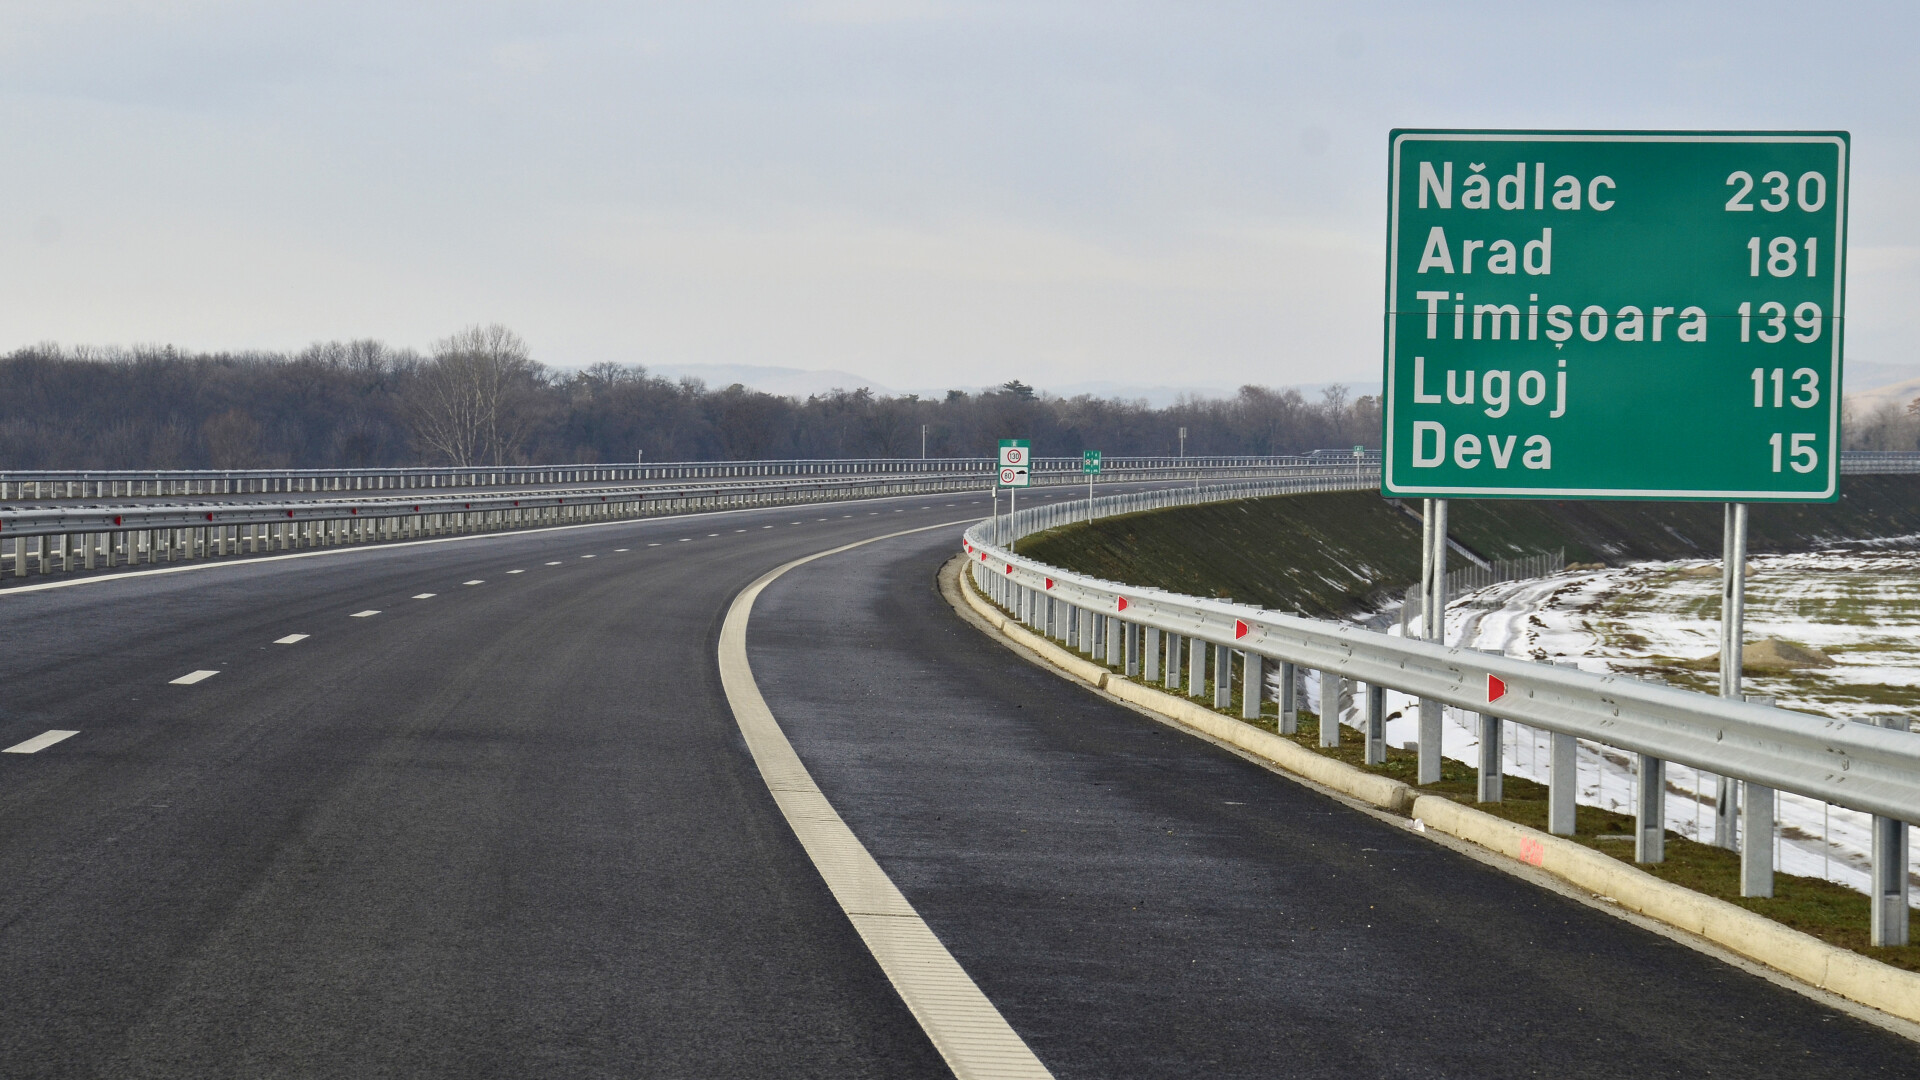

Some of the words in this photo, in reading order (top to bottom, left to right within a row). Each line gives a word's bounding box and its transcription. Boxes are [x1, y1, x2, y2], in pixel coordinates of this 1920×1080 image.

[1725, 170, 1827, 213] 230
[1417, 226, 1552, 276] Arad
[1747, 236, 1818, 278] 181
[1416, 290, 1708, 350] Timișoara
[1738, 301, 1823, 344] 139
[1413, 356, 1568, 419] Lugoj
[1751, 367, 1821, 409] 113
[1411, 420, 1552, 470] Deva
[1769, 432, 1819, 474] 15
